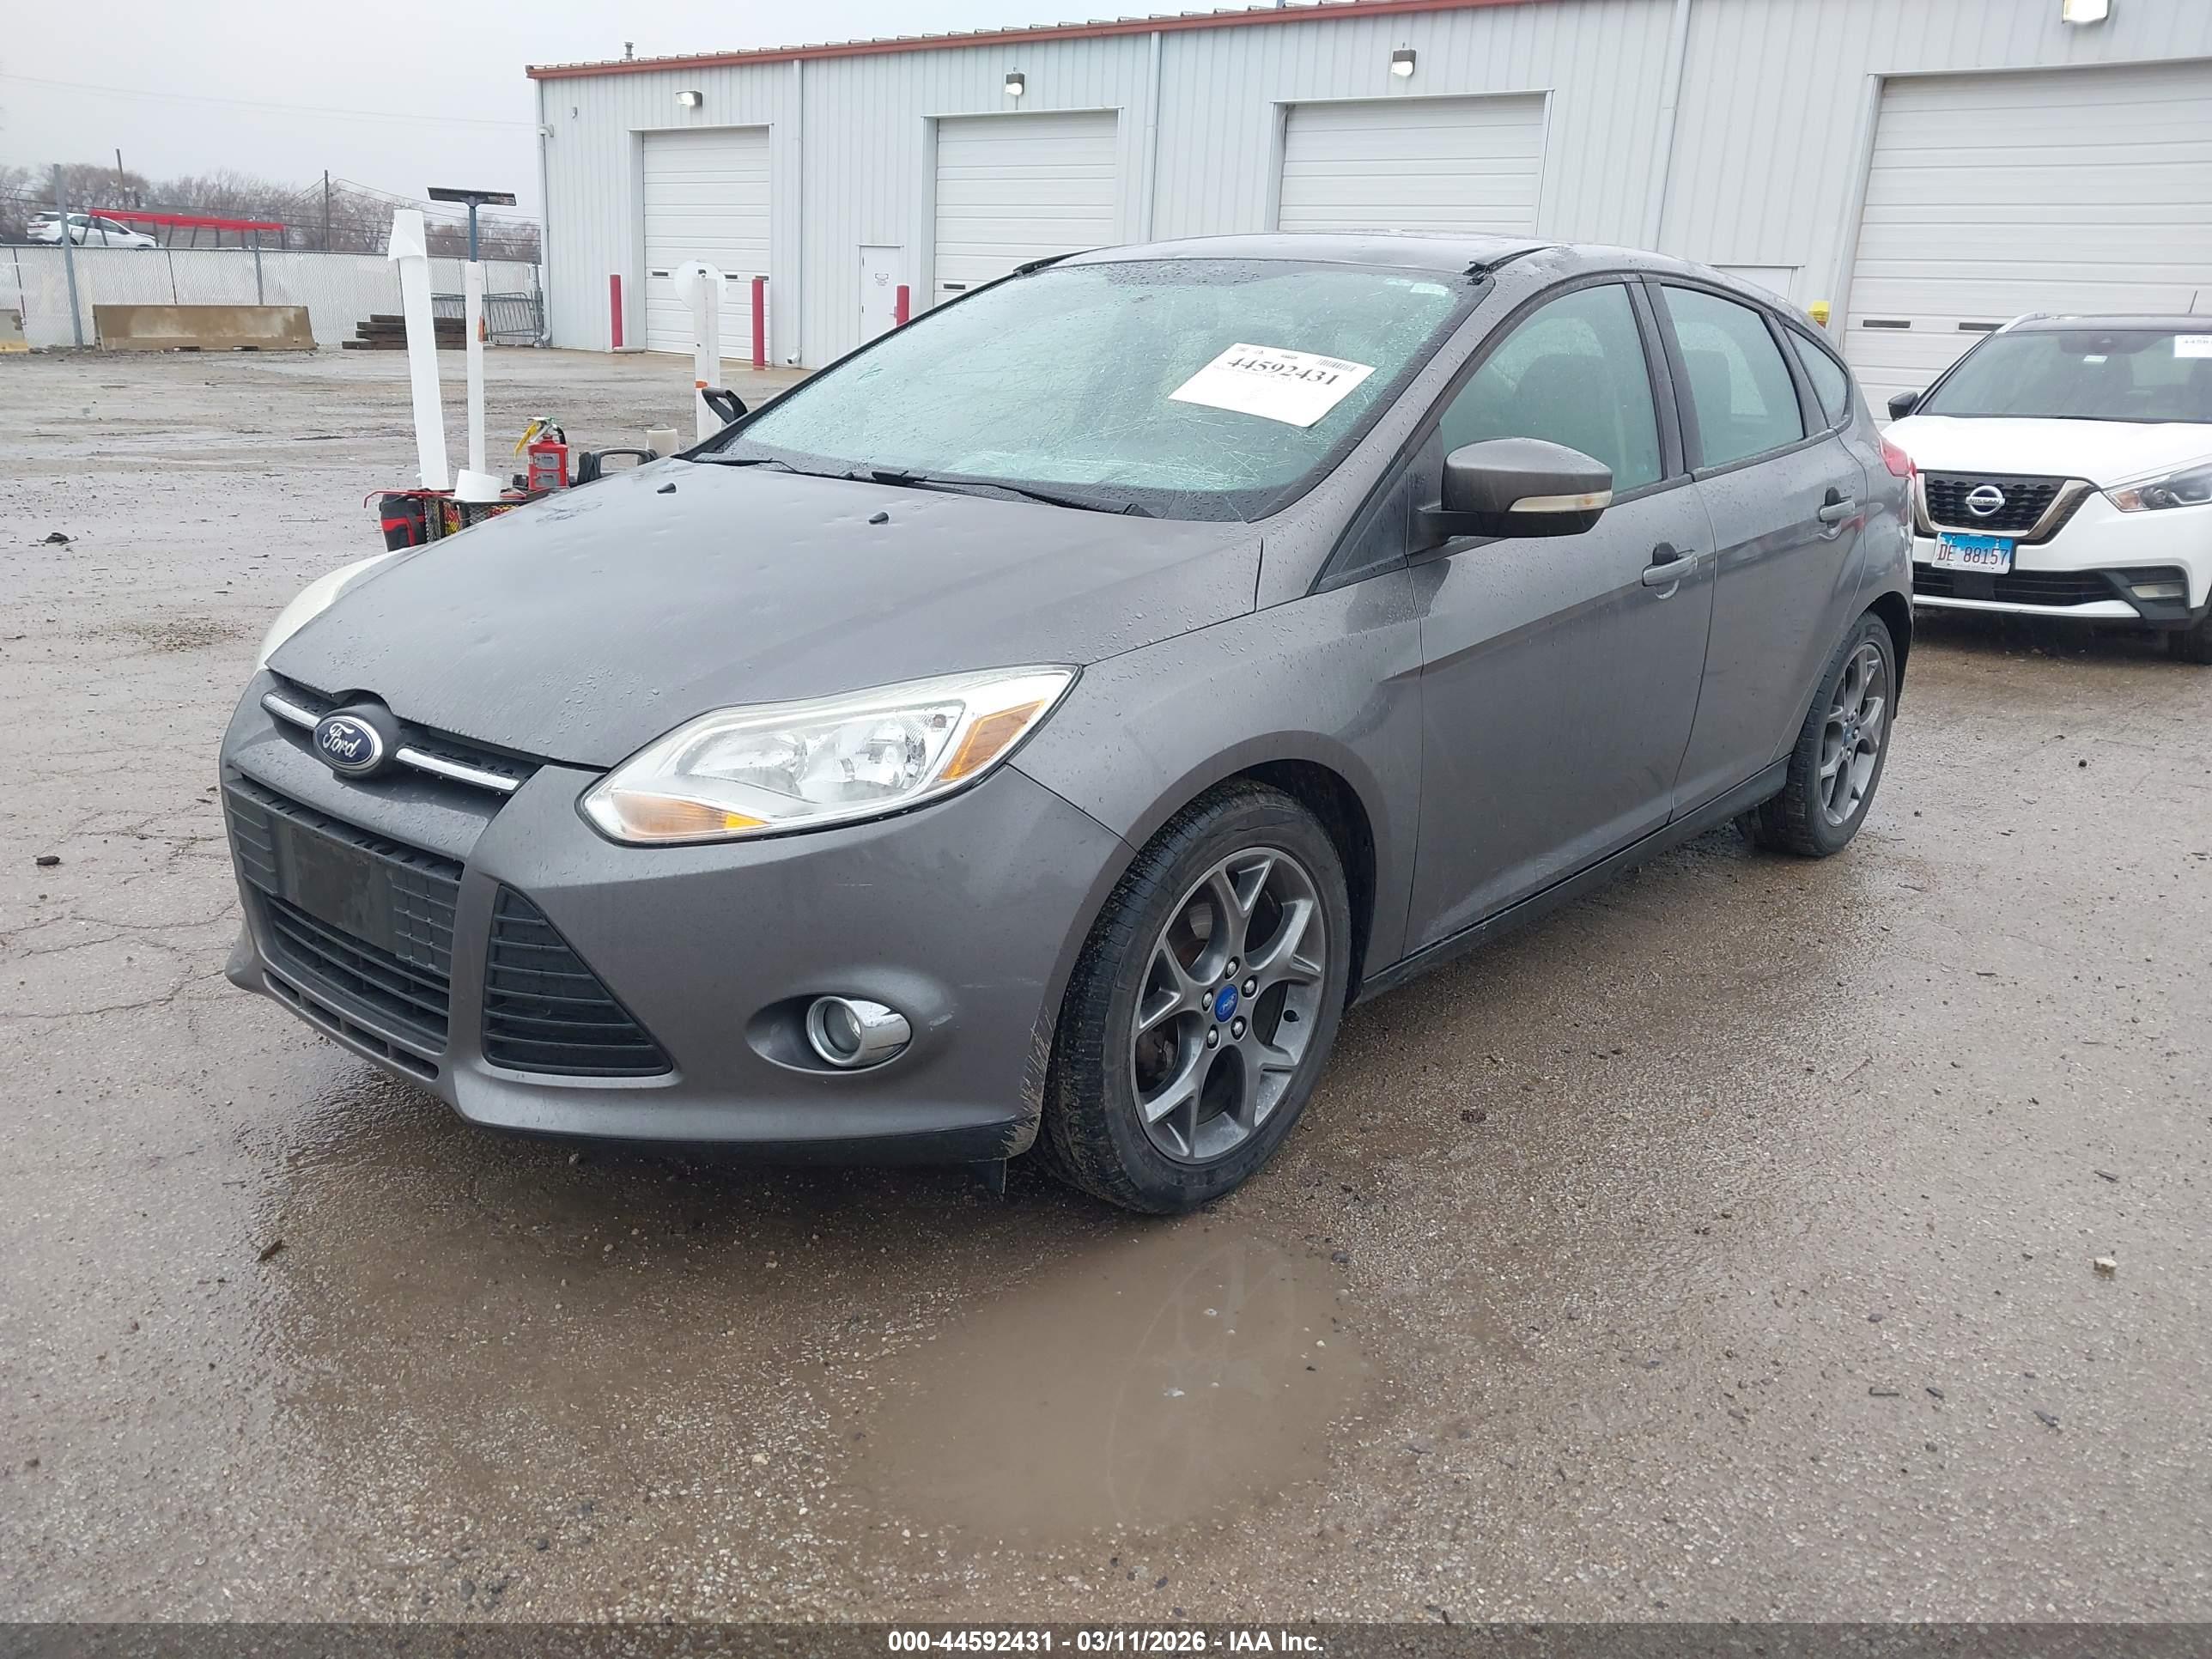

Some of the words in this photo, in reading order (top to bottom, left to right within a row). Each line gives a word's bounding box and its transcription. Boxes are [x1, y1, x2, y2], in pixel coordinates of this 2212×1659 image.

[1227, 356, 1340, 386] 44592431
[1937, 544, 1958, 562] DE
[1963, 546, 2009, 566] 88157
[322, 722, 362, 757] Ford
